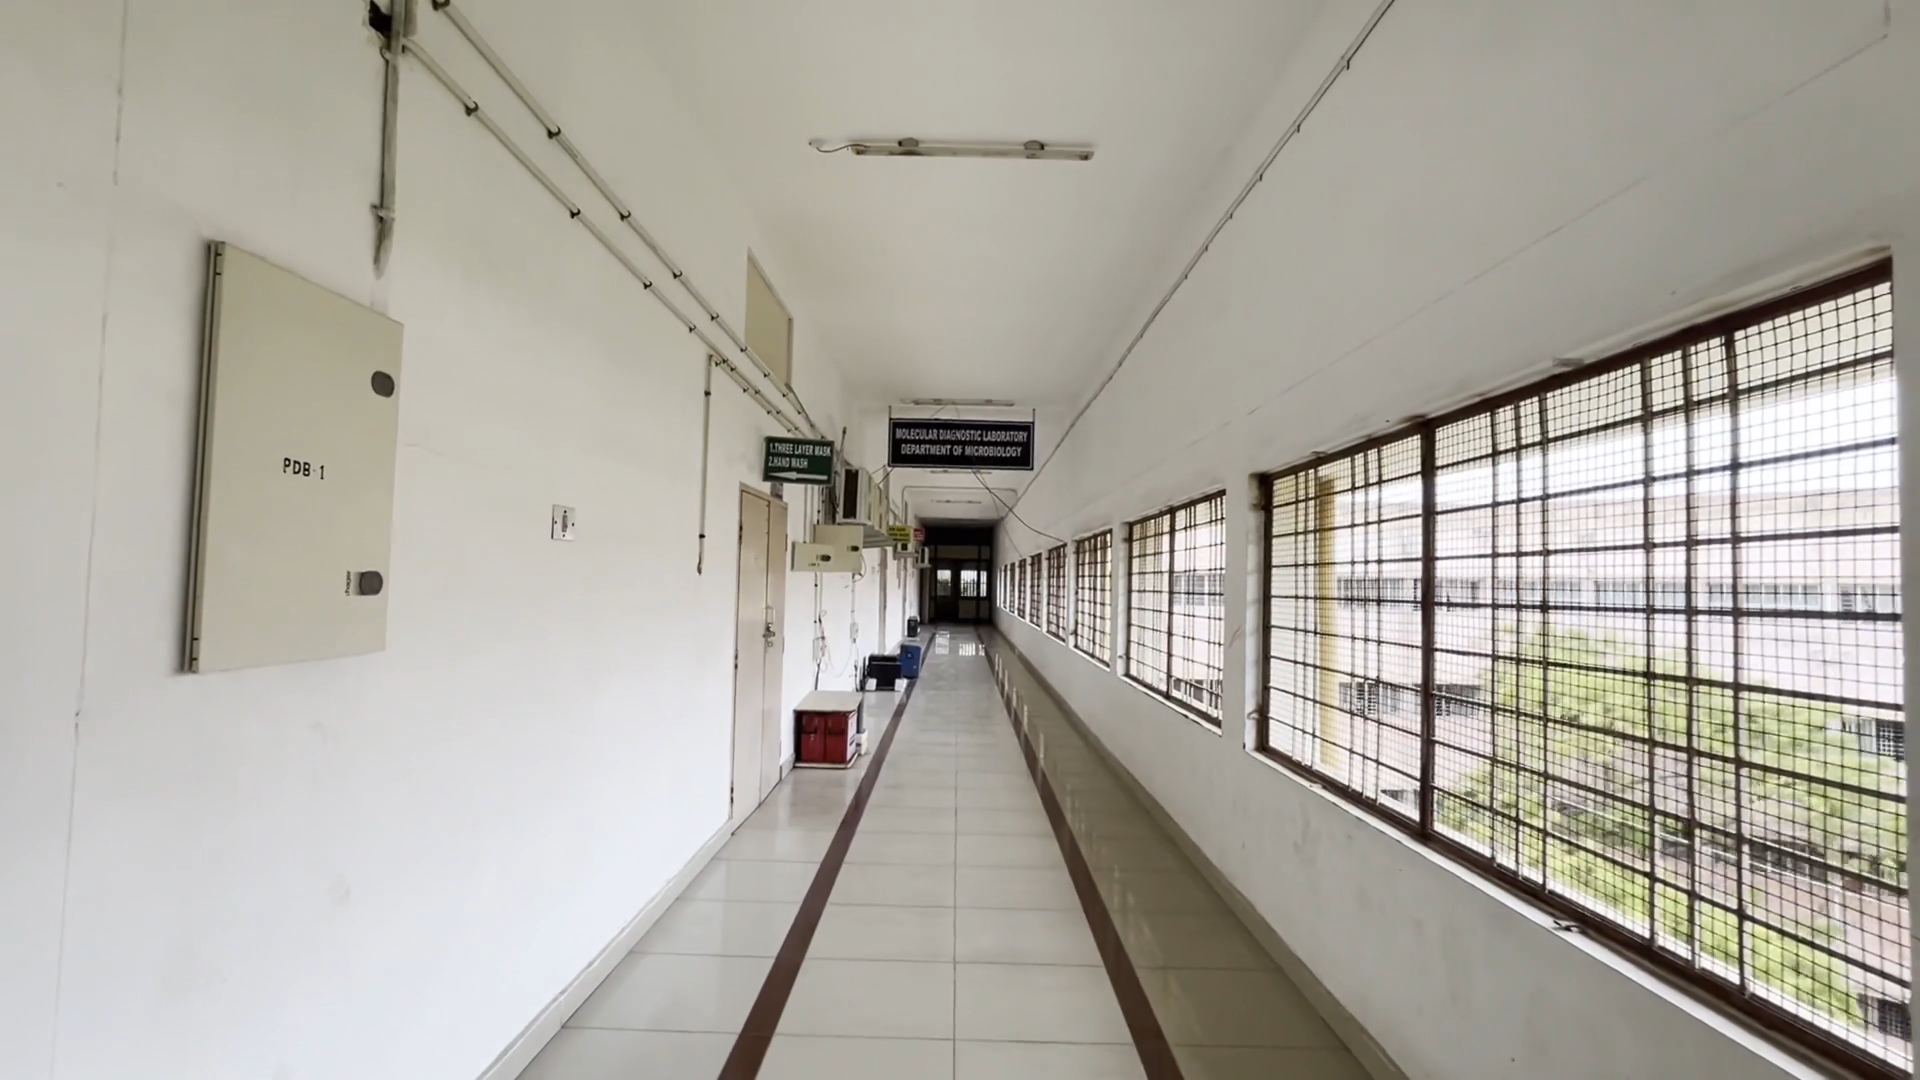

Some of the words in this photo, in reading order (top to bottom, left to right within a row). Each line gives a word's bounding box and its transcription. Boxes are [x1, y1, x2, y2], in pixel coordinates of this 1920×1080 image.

[895, 427, 938, 440] MOLECULAR
[938, 428, 982, 441] DIAGNOSTIC
[982, 430, 1028, 442] LABORATORY
[794, 443, 814, 456] LAYER
[900, 443, 951, 456] DEPARTMENT
[952, 445, 963, 456] OF
[964, 445, 1022, 457] MICROBIOLOGY
[790, 457, 808, 469] WASH
